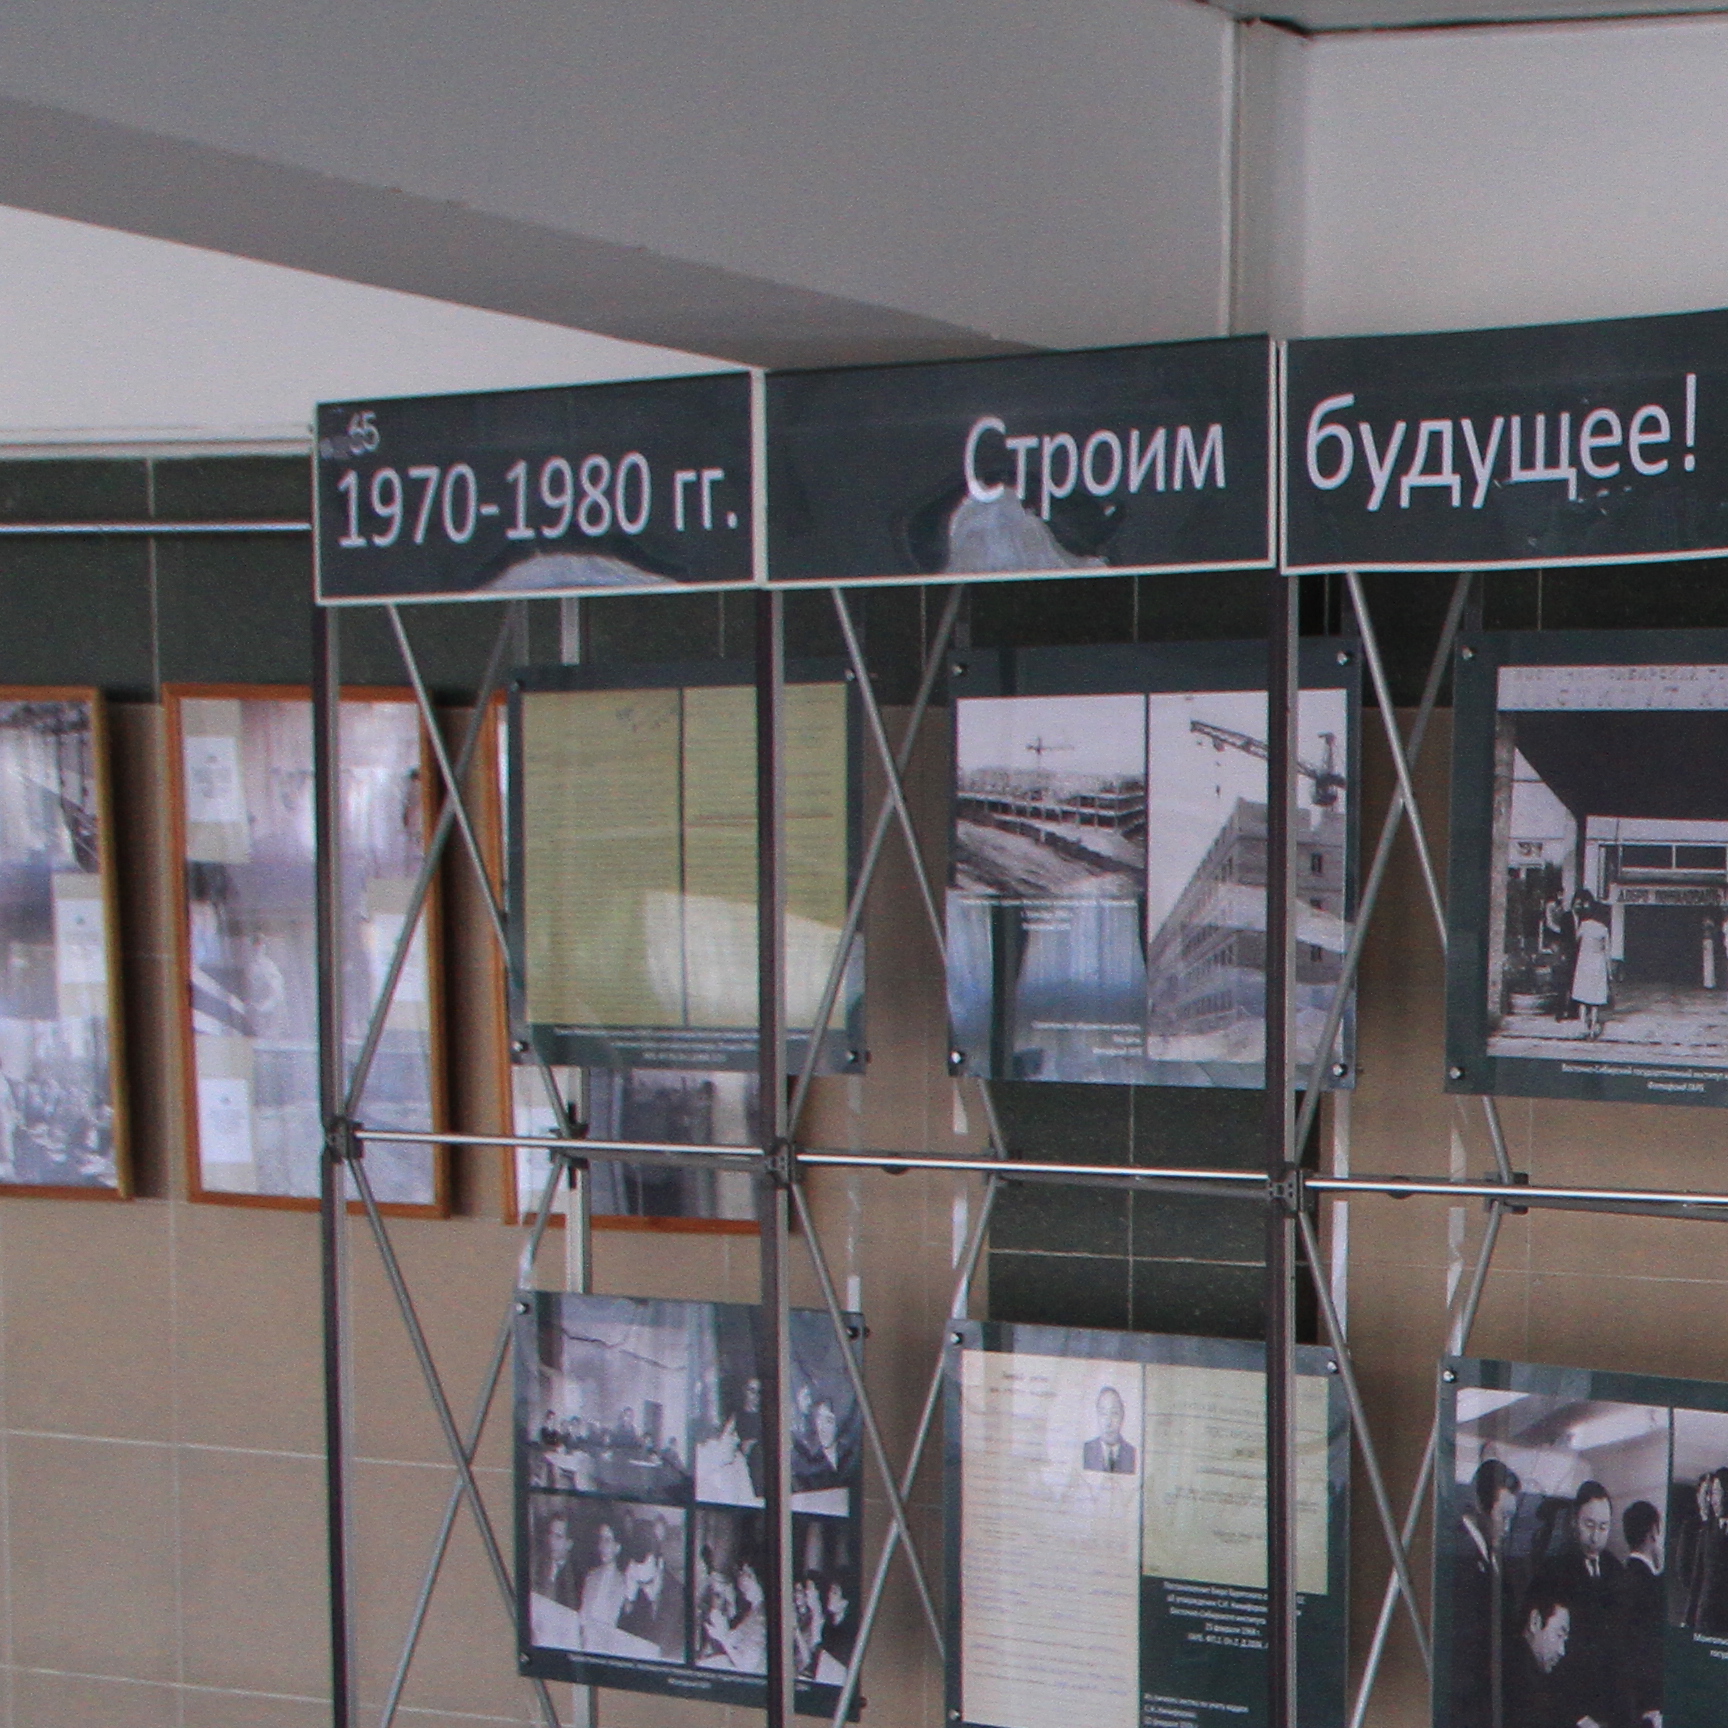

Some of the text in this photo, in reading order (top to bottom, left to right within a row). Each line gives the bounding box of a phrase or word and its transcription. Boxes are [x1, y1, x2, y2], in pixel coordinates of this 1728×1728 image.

[338, 372, 1697, 548] 1970-1980 гг. Строим будущее!
